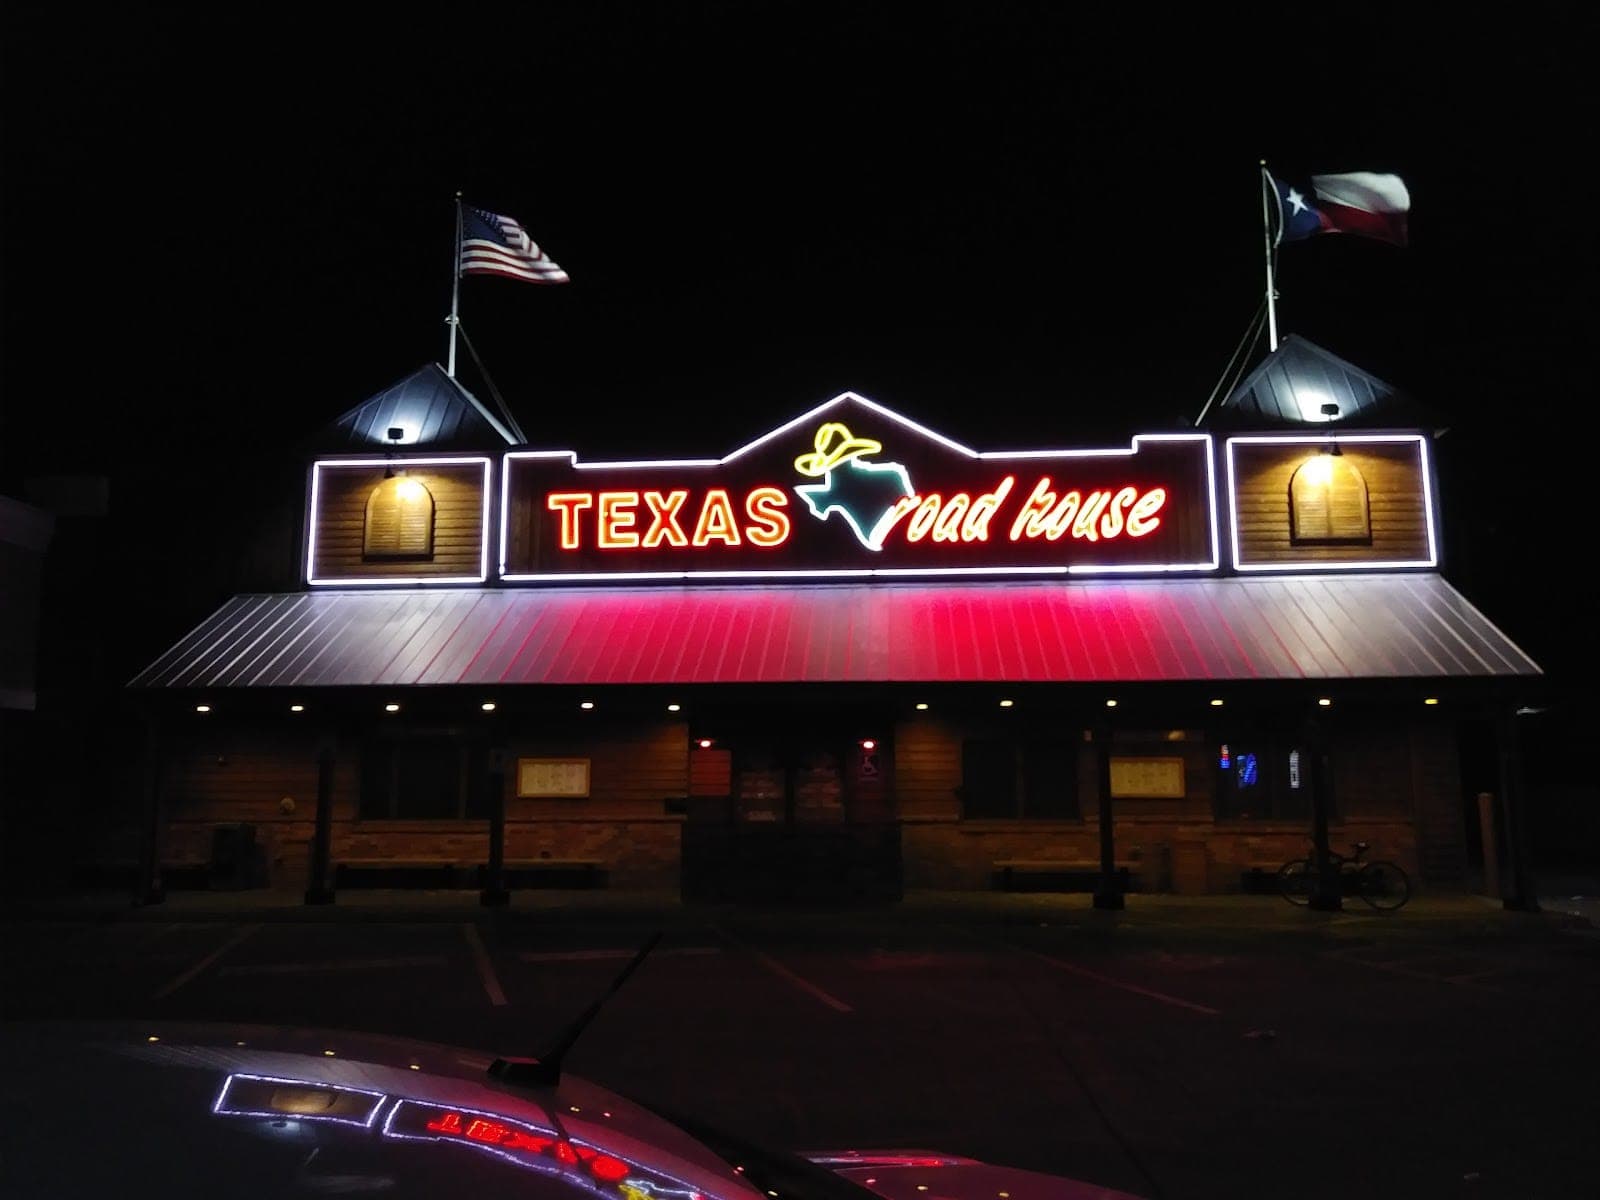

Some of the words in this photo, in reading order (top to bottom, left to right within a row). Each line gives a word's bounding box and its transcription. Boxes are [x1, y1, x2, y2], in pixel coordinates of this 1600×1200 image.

[547, 486, 791, 550] TEXAS
[869, 475, 1015, 549] road
[1009, 476, 1167, 542] house
